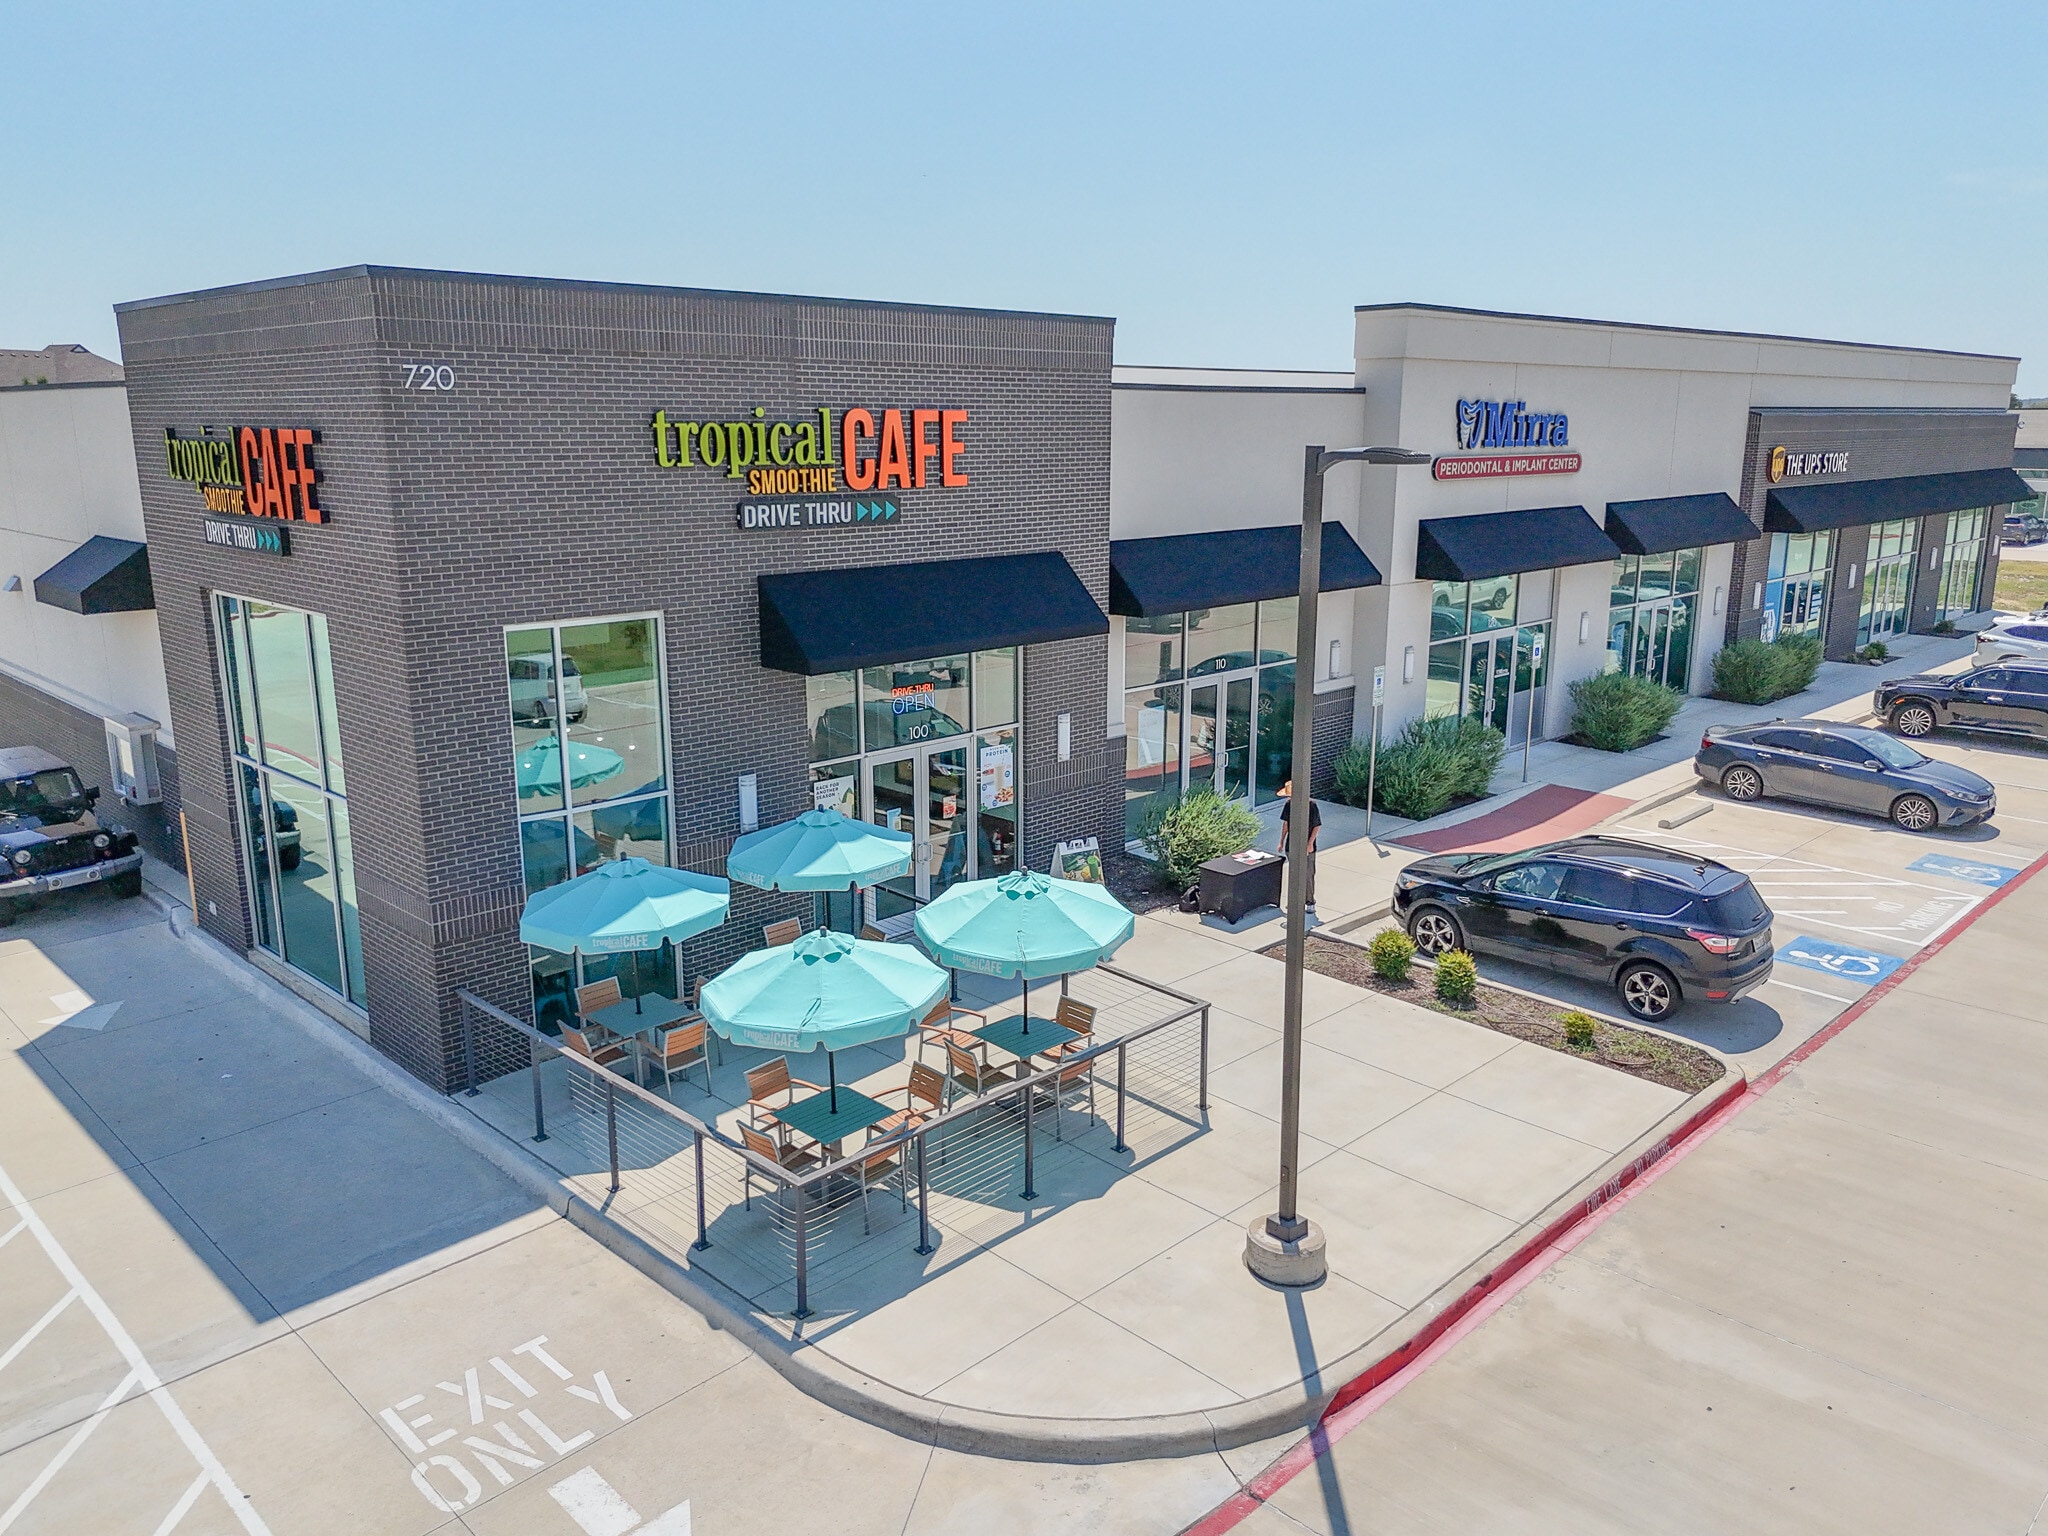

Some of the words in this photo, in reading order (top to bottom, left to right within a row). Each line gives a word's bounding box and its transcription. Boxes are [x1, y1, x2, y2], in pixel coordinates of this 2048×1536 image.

[402, 364, 455, 391] 720
[1484, 401, 1569, 448] Mirra
[652, 407, 836, 479] tropical
[843, 408, 968, 491] CAFE
[164, 425, 243, 492] tropical
[239, 426, 322, 525] CAFE
[1439, 460, 1502, 476] PERIODONTAL
[1504, 461, 1511, 473] &
[1511, 458, 1548, 473] IMPLANT
[1548, 457, 1579, 471] CENTER
[1786, 454, 1804, 476] THE
[1804, 453, 1822, 475] UPS
[1822, 452, 1849, 474] STORE
[749, 467, 838, 495] SMOOTHIE
[203, 485, 247, 516] SMOOTHIE
[744, 501, 801, 529] DRIVE
[804, 500, 852, 525] THRU
[205, 519, 231, 547] DRIVE
[231, 525, 257, 550] THRU
[1215, 658, 1226, 670] 110
[892, 683, 934, 698] DRIVE-THRU
[892, 692, 935, 714] OPEN
[909, 724, 929, 740] 100
[815, 787, 839, 796] ANOTHER
[1898, 900, 1954, 931] PARKING
[623, 934, 648, 948] CAFE
[978, 958, 1003, 974] CAFE
[773, 1031, 800, 1049] CAFE
[1585, 1190, 1603, 1216] FIRE
[1603, 1175, 1623, 1201] LANE
[1634, 1158, 1644, 1177] NO
[1645, 1139, 1670, 1168] PARKING
[379, 1334, 574, 1454] EXIT
[410, 1370, 634, 1513] ONLY
